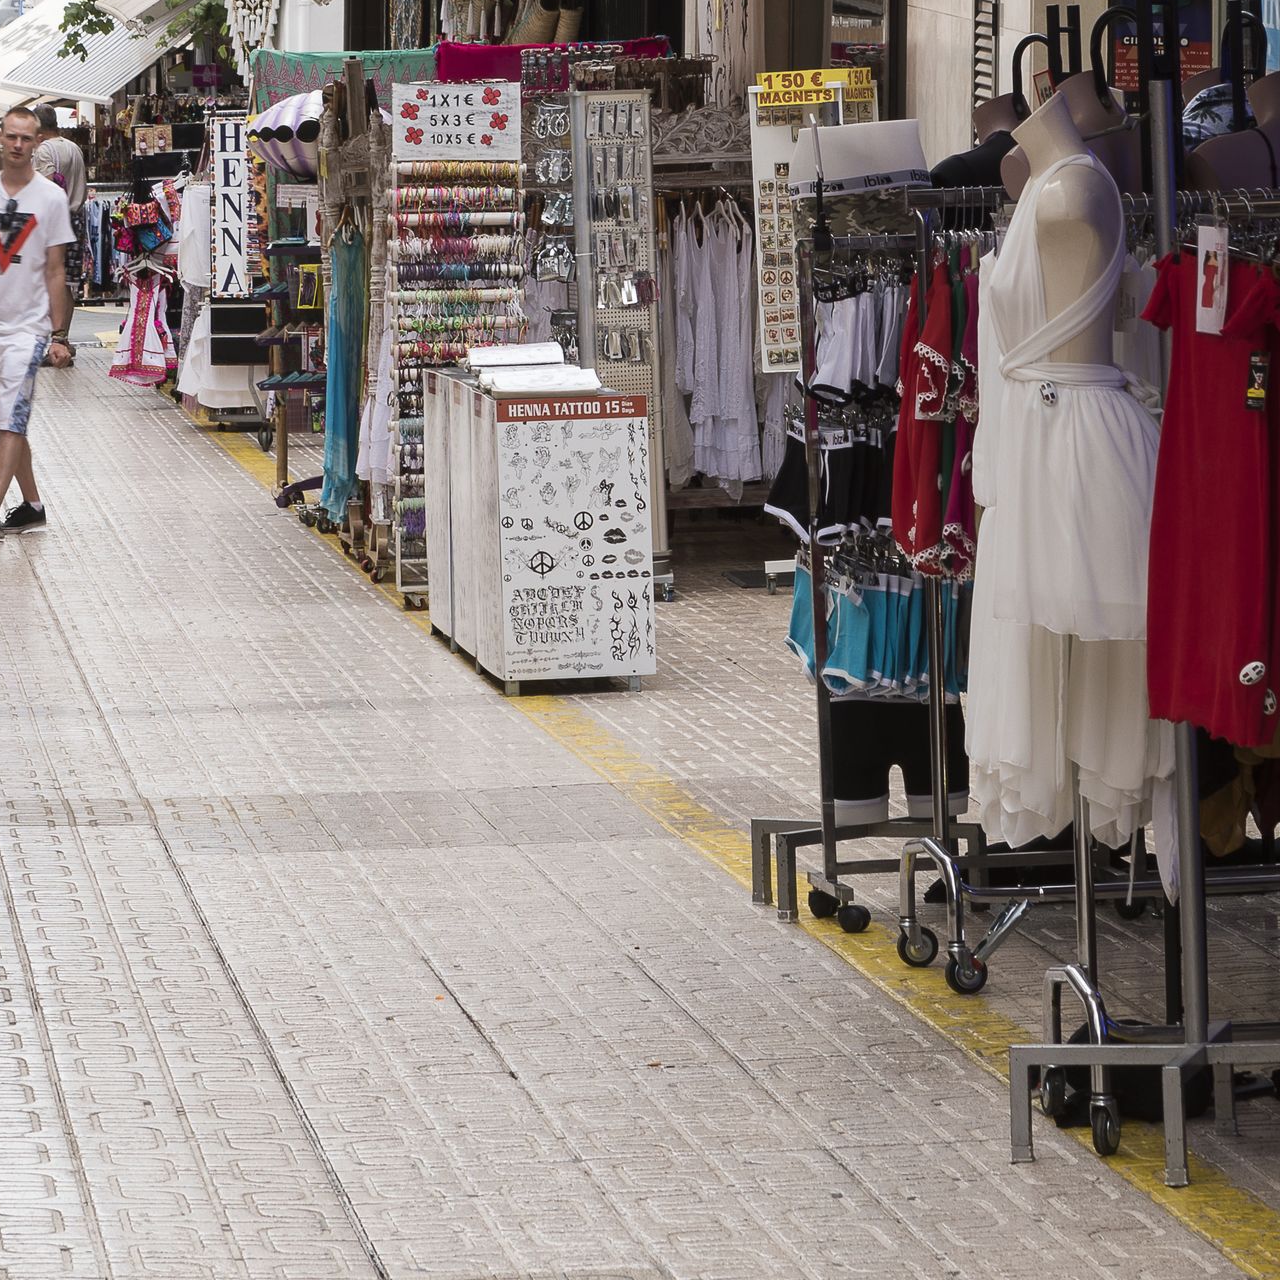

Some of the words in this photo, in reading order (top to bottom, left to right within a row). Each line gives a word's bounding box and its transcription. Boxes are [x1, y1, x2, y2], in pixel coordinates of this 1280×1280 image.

[810, 71, 823, 88] €
[759, 89, 833, 106] MAGNETS
[845, 87, 875, 101] MAGNETS
[217, 122, 244, 293] HENNA
[508, 402, 551, 418] HENNA
[553, 400, 601, 417] TATTOO
[604, 400, 620, 414] 15
